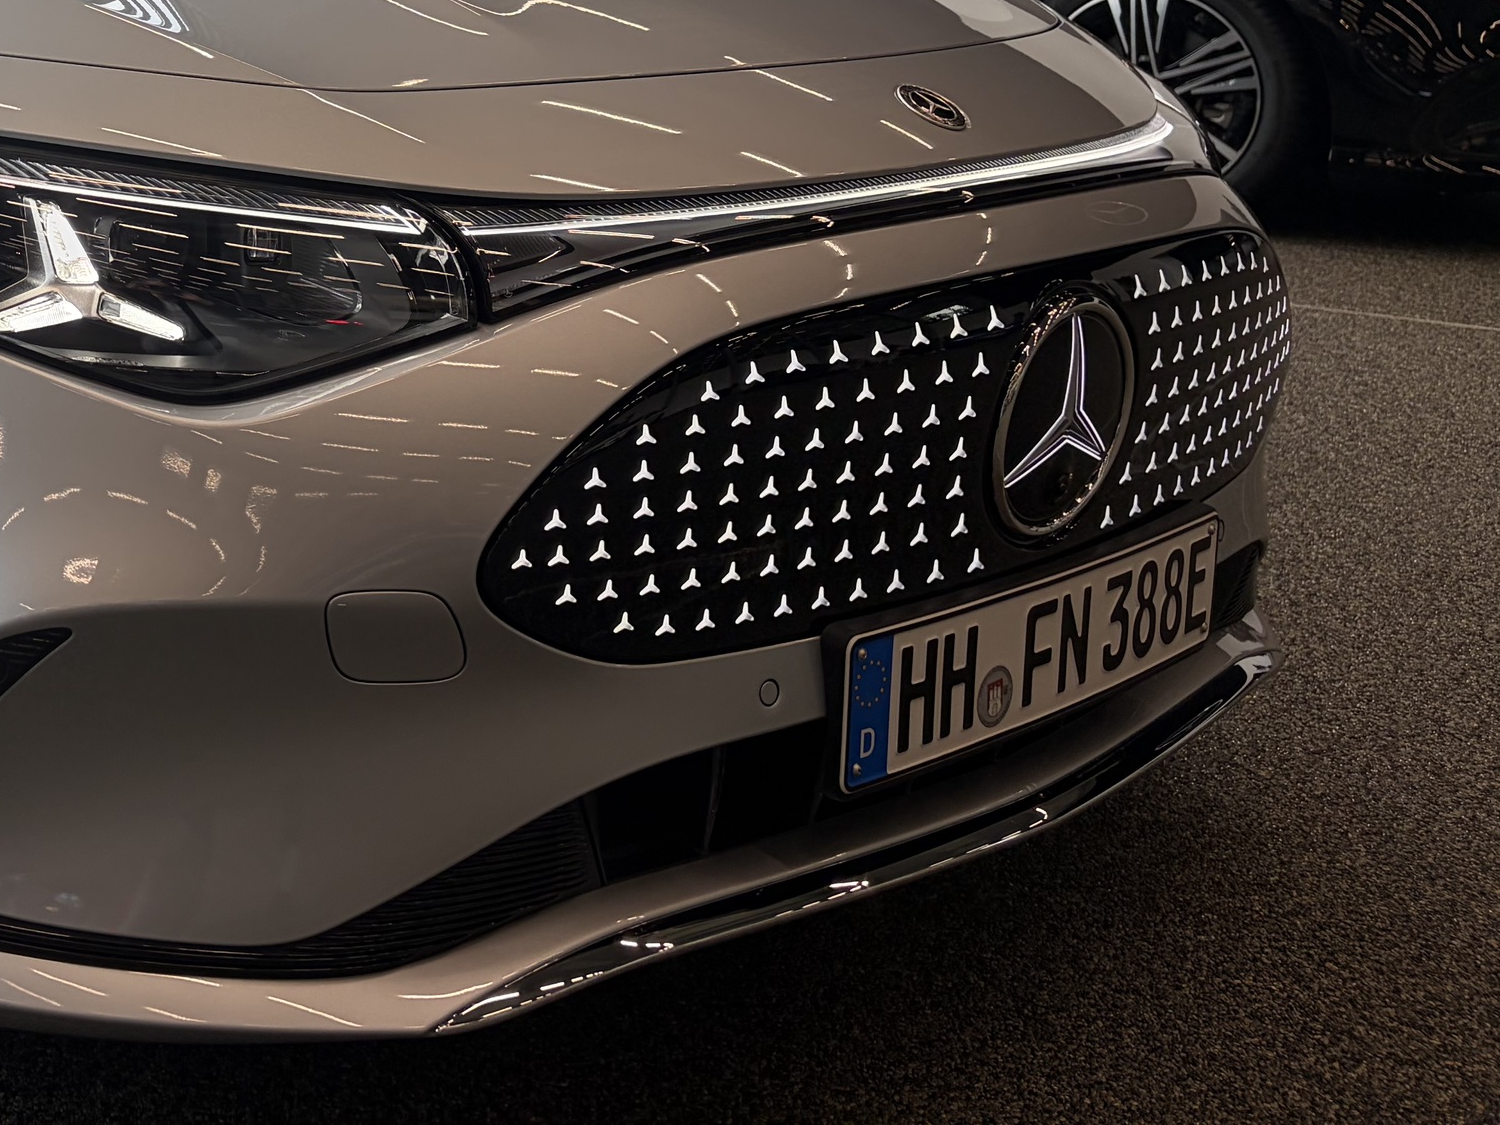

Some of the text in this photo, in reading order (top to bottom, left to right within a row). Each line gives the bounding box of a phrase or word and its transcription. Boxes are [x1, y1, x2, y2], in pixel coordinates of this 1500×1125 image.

[897, 538, 1211, 754] HH FN 388E
[860, 727, 875, 759] D
